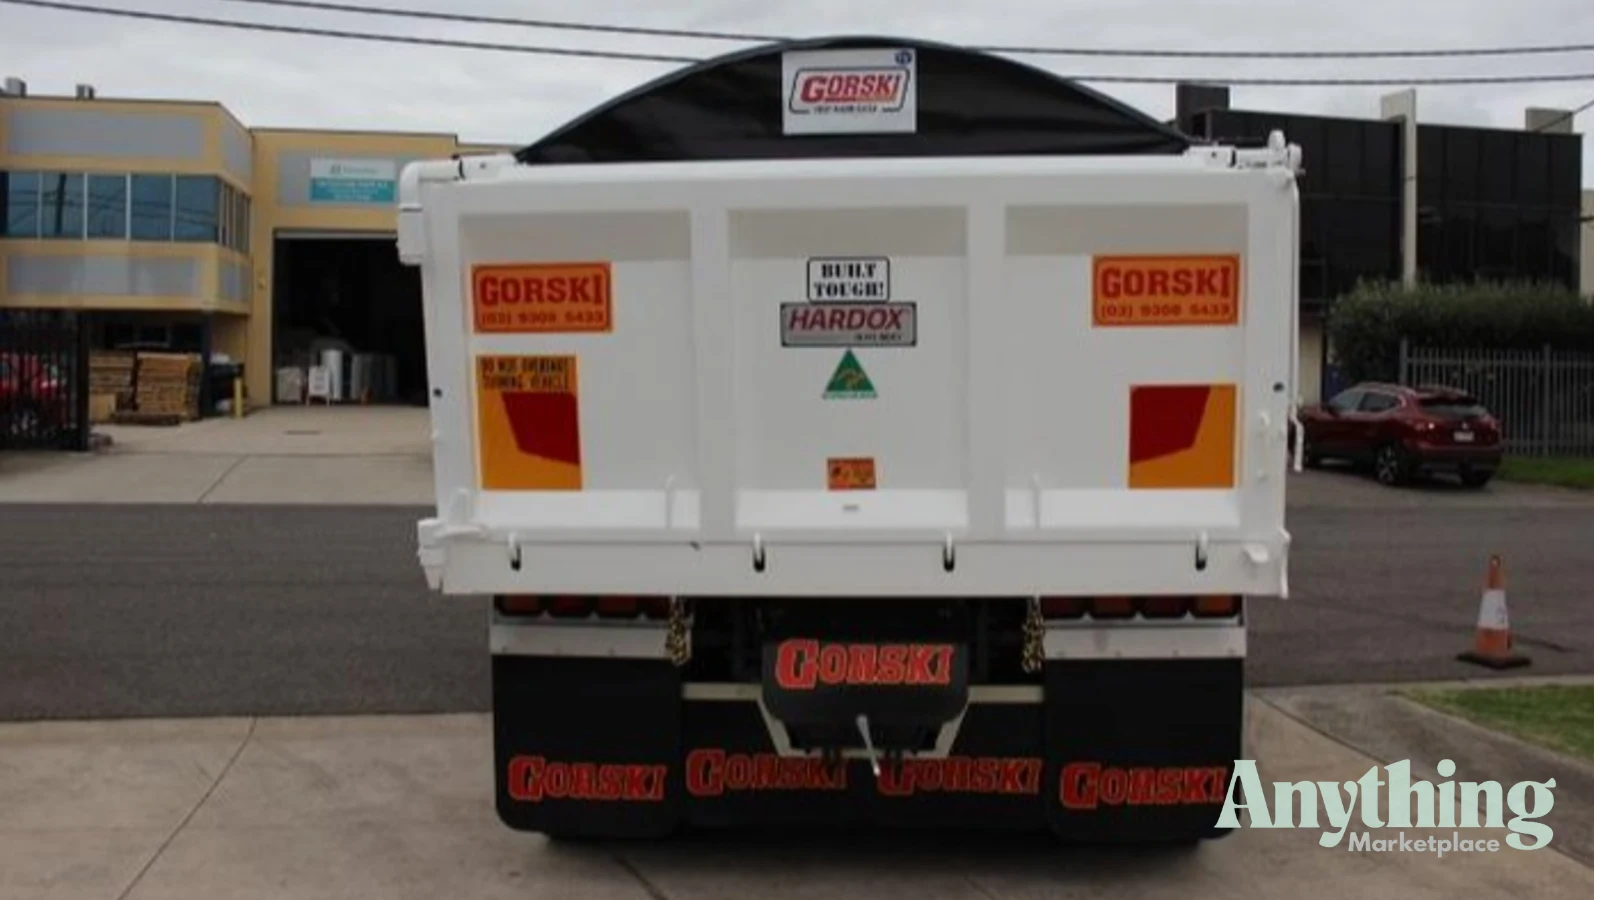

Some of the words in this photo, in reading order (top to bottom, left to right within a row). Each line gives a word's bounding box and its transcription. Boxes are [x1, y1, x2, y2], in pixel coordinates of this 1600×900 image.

[801, 73, 902, 104] GORSKI
[821, 263, 877, 278] BUILT
[1101, 266, 1231, 298] GORSKI
[480, 274, 603, 306] GORSKI
[814, 281, 884, 297] TOUGH!
[788, 308, 902, 331] HARDOX
[775, 638, 954, 690] GORSKI
[508, 756, 667, 801] GORSKI
[686, 748, 848, 796] GORSKI
[1059, 760, 1228, 809] GORSKI
